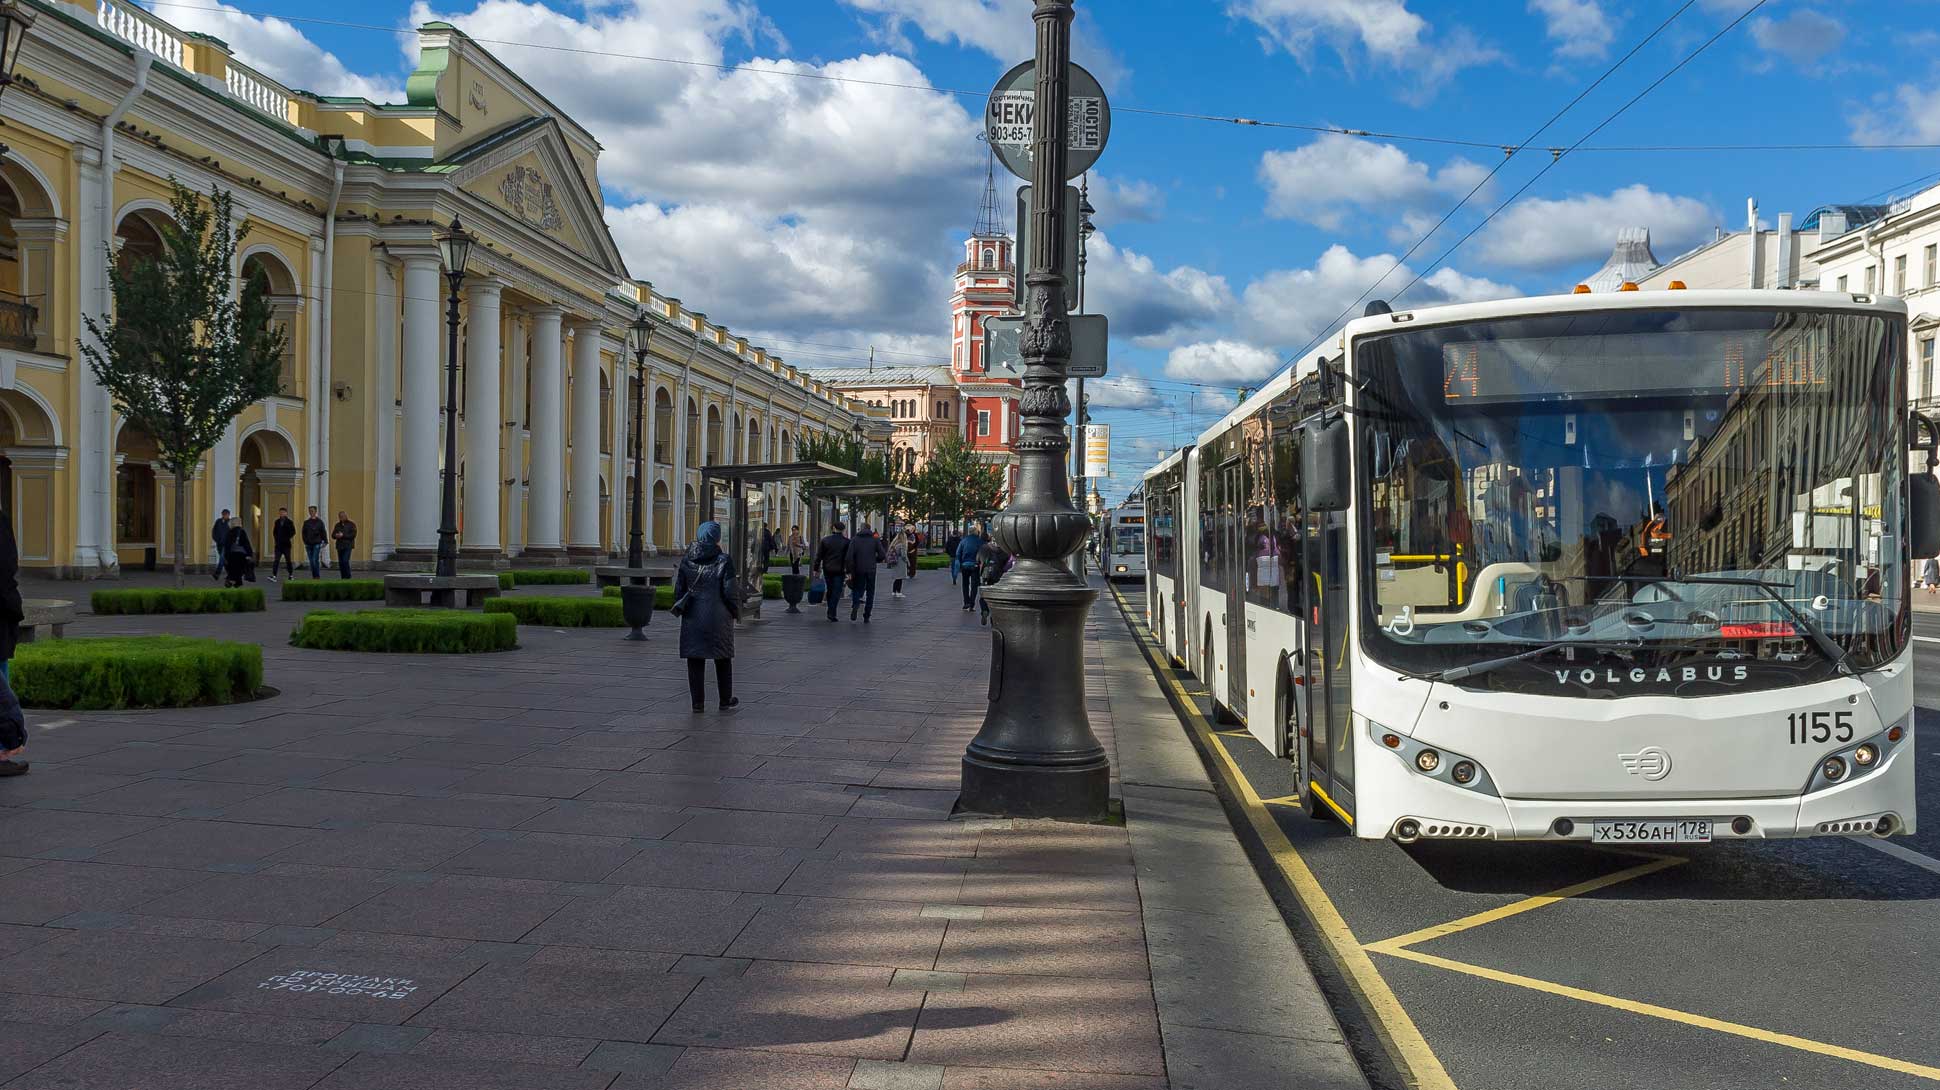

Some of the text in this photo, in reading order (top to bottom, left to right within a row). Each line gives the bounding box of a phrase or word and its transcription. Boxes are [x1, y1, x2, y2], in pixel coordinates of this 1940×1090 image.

[1086, 100, 1098, 145] ХОСТЕЛ
[1554, 666, 1748, 685] VOLGABUS
[1787, 711, 1854, 745] 1155
[1679, 821, 1707, 835] 178
[267, 975, 420, 993] ПО КРЫШАМ
[290, 970, 415, 986] ПРОГУЛКИ
